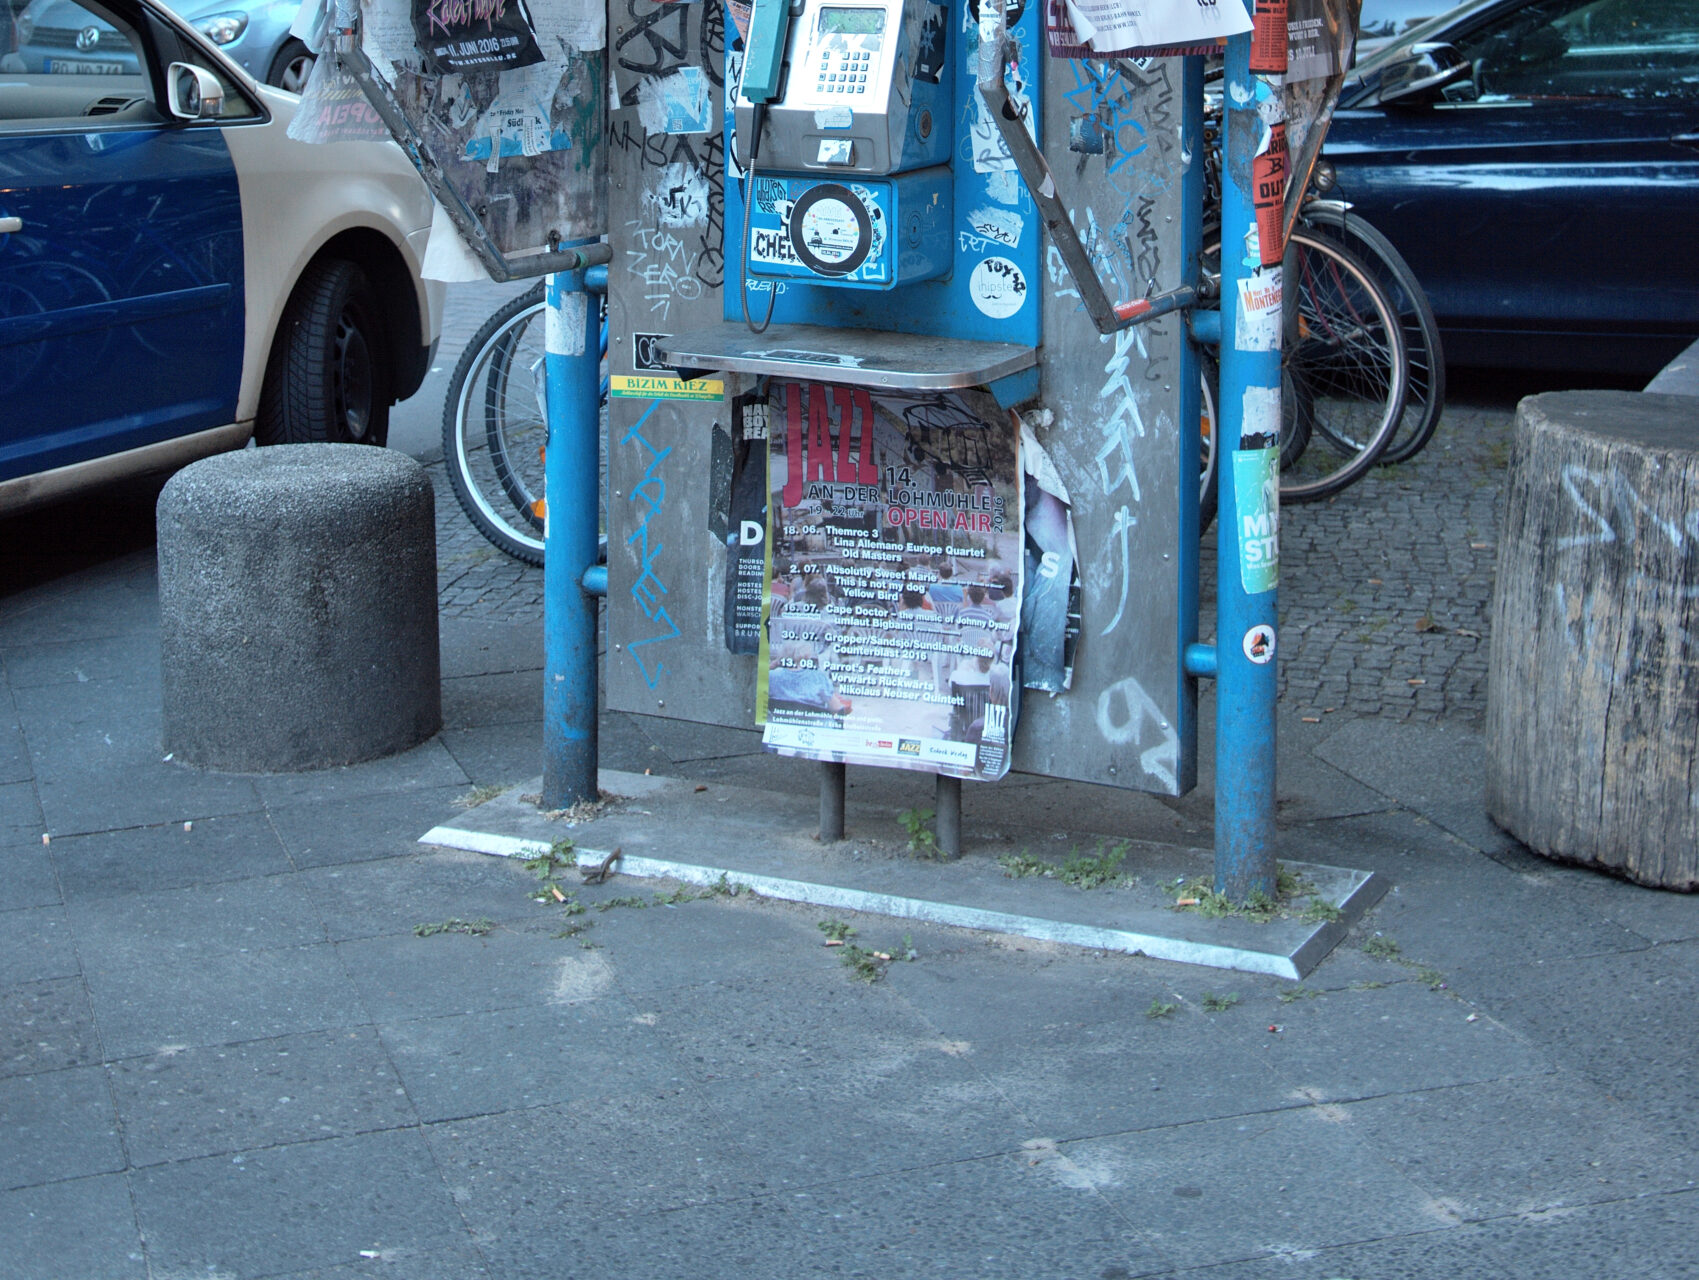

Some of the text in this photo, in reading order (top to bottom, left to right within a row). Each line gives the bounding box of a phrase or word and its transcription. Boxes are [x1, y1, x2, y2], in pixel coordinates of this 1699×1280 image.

[460, 40, 479, 56] JUNI
[478, 37, 500, 53] 2016
[783, 382, 878, 508] JAZZ
[886, 467, 916, 488] 14.
[808, 484, 991, 510] AN DER LOHMÜHLE
[809, 505, 865, 518] 19 22 Uhr
[888, 506, 991, 532] OPEN AIR
[993, 496, 1004, 534] 2016
[783, 525, 879, 538] 18. 06. Themroc 3
[834, 537, 985, 558] Lina Allemano Europe Quartet
[842, 549, 902, 563] Old Masters
[803, 564, 820, 574] 07.
[875, 568, 906, 580] Sweet
[908, 571, 937, 583] Marie
[1041, 552, 1060, 578] S
[835, 576, 925, 594] This is not my dog
[843, 588, 899, 602] Yellow Bird
[803, 604, 819, 614] 07.
[826, 604, 853, 616] Cape
[855, 607, 888, 618] Doctor
[899, 610, 914, 621] the
[916, 613, 942, 623] music
[945, 615, 955, 624] of
[956, 616, 987, 629] Johnny
[834, 616, 913, 631] umlaut Bigband
[782, 630, 799, 640] 30.
[802, 631, 818, 641] 07.
[833, 644, 927, 661] Counterblast 2016
[780, 658, 797, 668] 13.
[800, 659, 817, 669] 08.
[867, 664, 911, 677] Feathers
[831, 673, 934, 691] Vorwärts Rückwärts
[840, 685, 965, 707] Nikolaus Neuser Quintett
